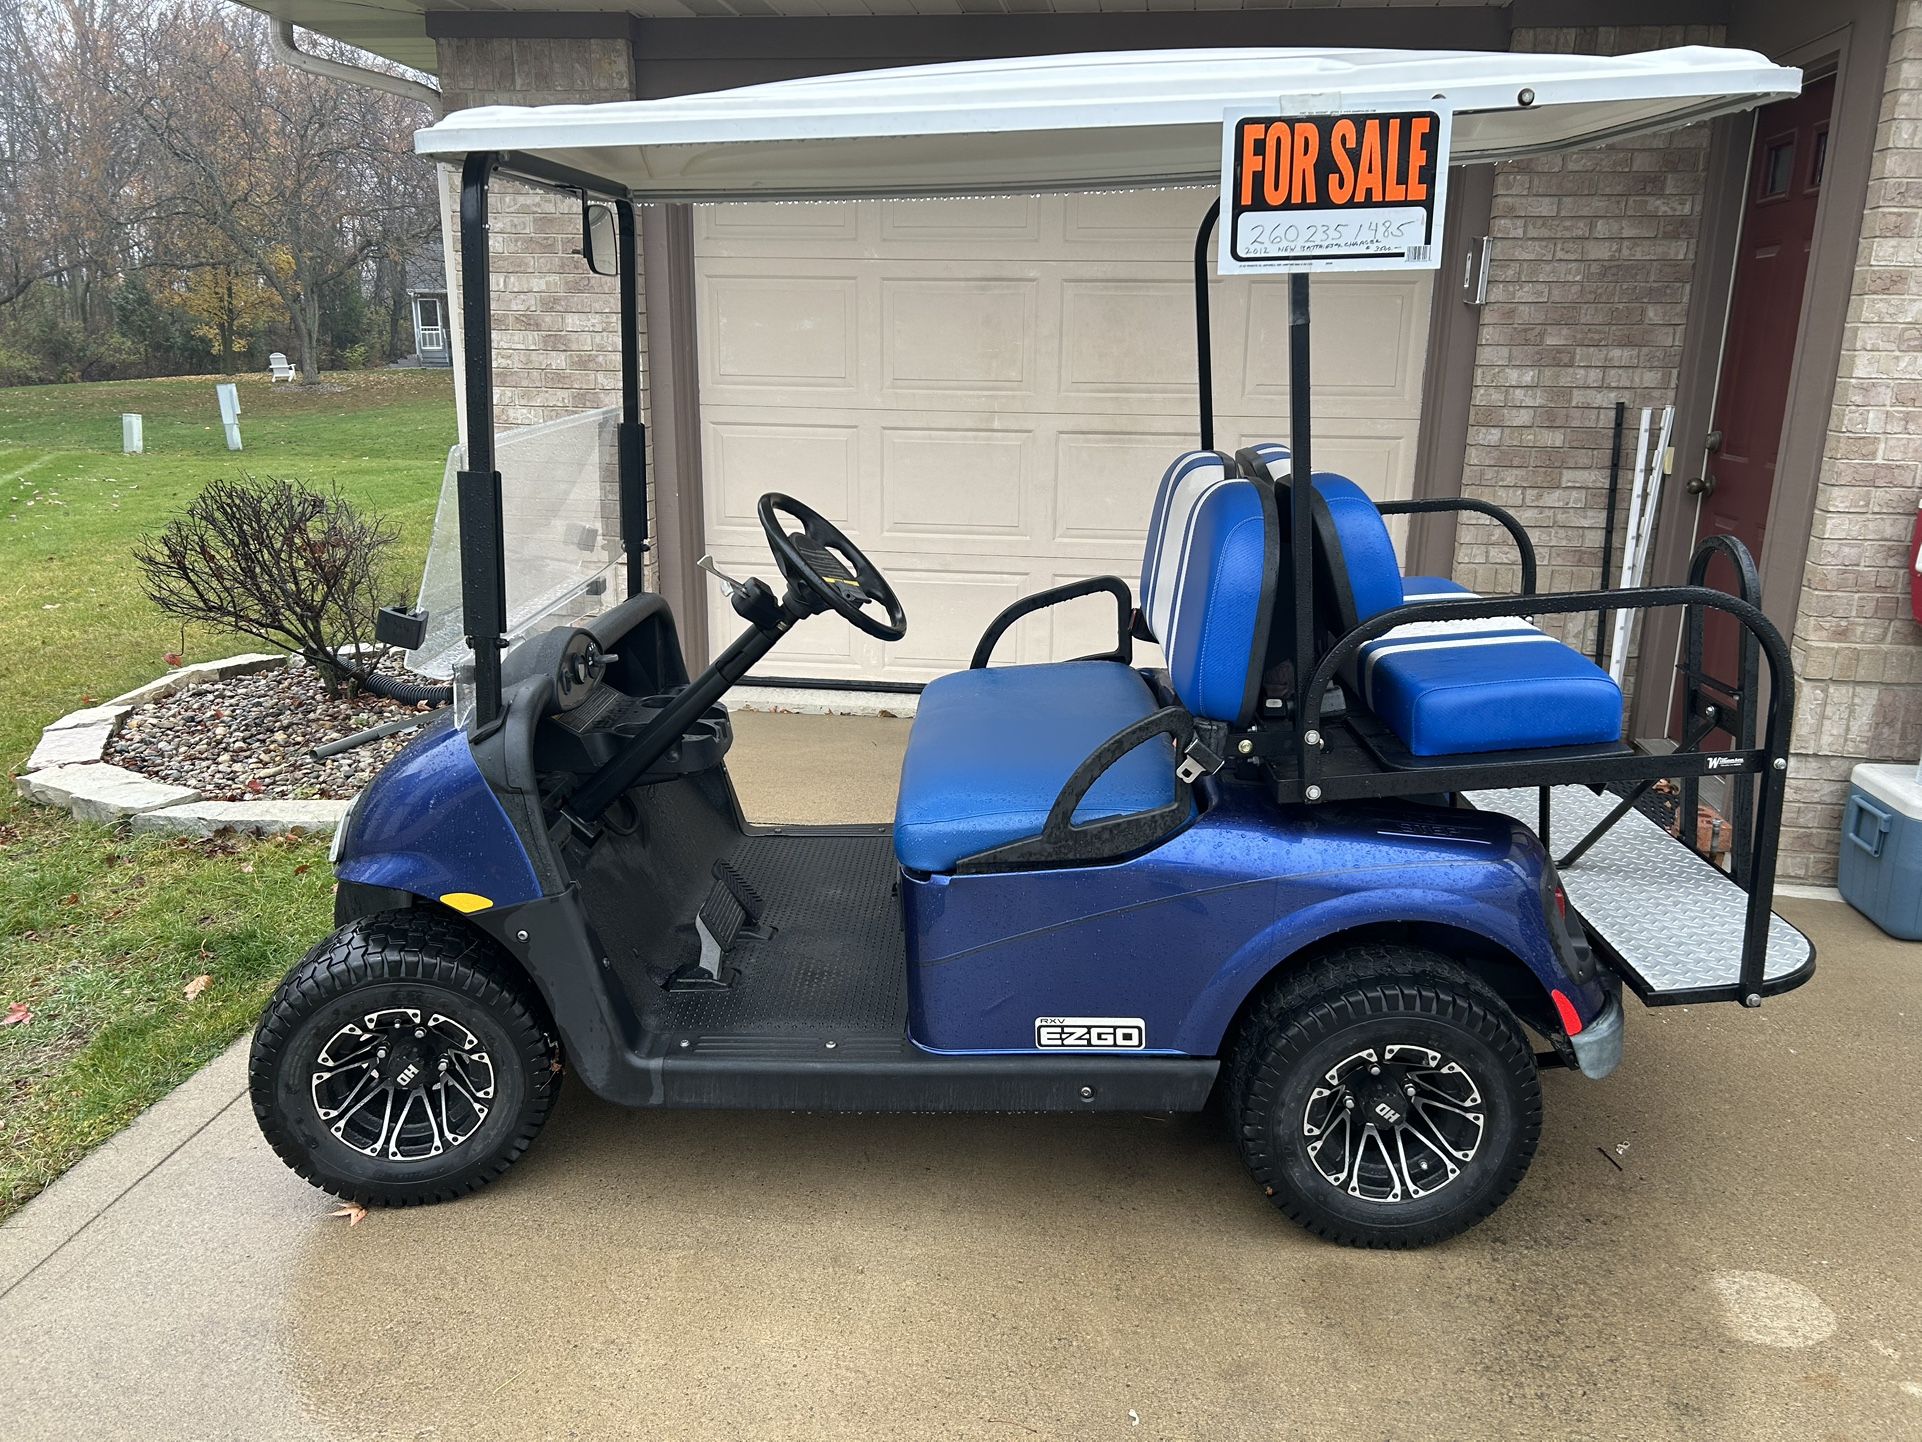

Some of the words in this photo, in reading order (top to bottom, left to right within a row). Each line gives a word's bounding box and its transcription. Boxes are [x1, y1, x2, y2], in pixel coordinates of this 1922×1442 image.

[1240, 121, 1320, 206] FOR
[1328, 117, 1431, 205] SALE
[1245, 246, 1270, 255] 2012
[1277, 244, 1297, 253] NEW
[1039, 1026, 1140, 1046] EZGO
